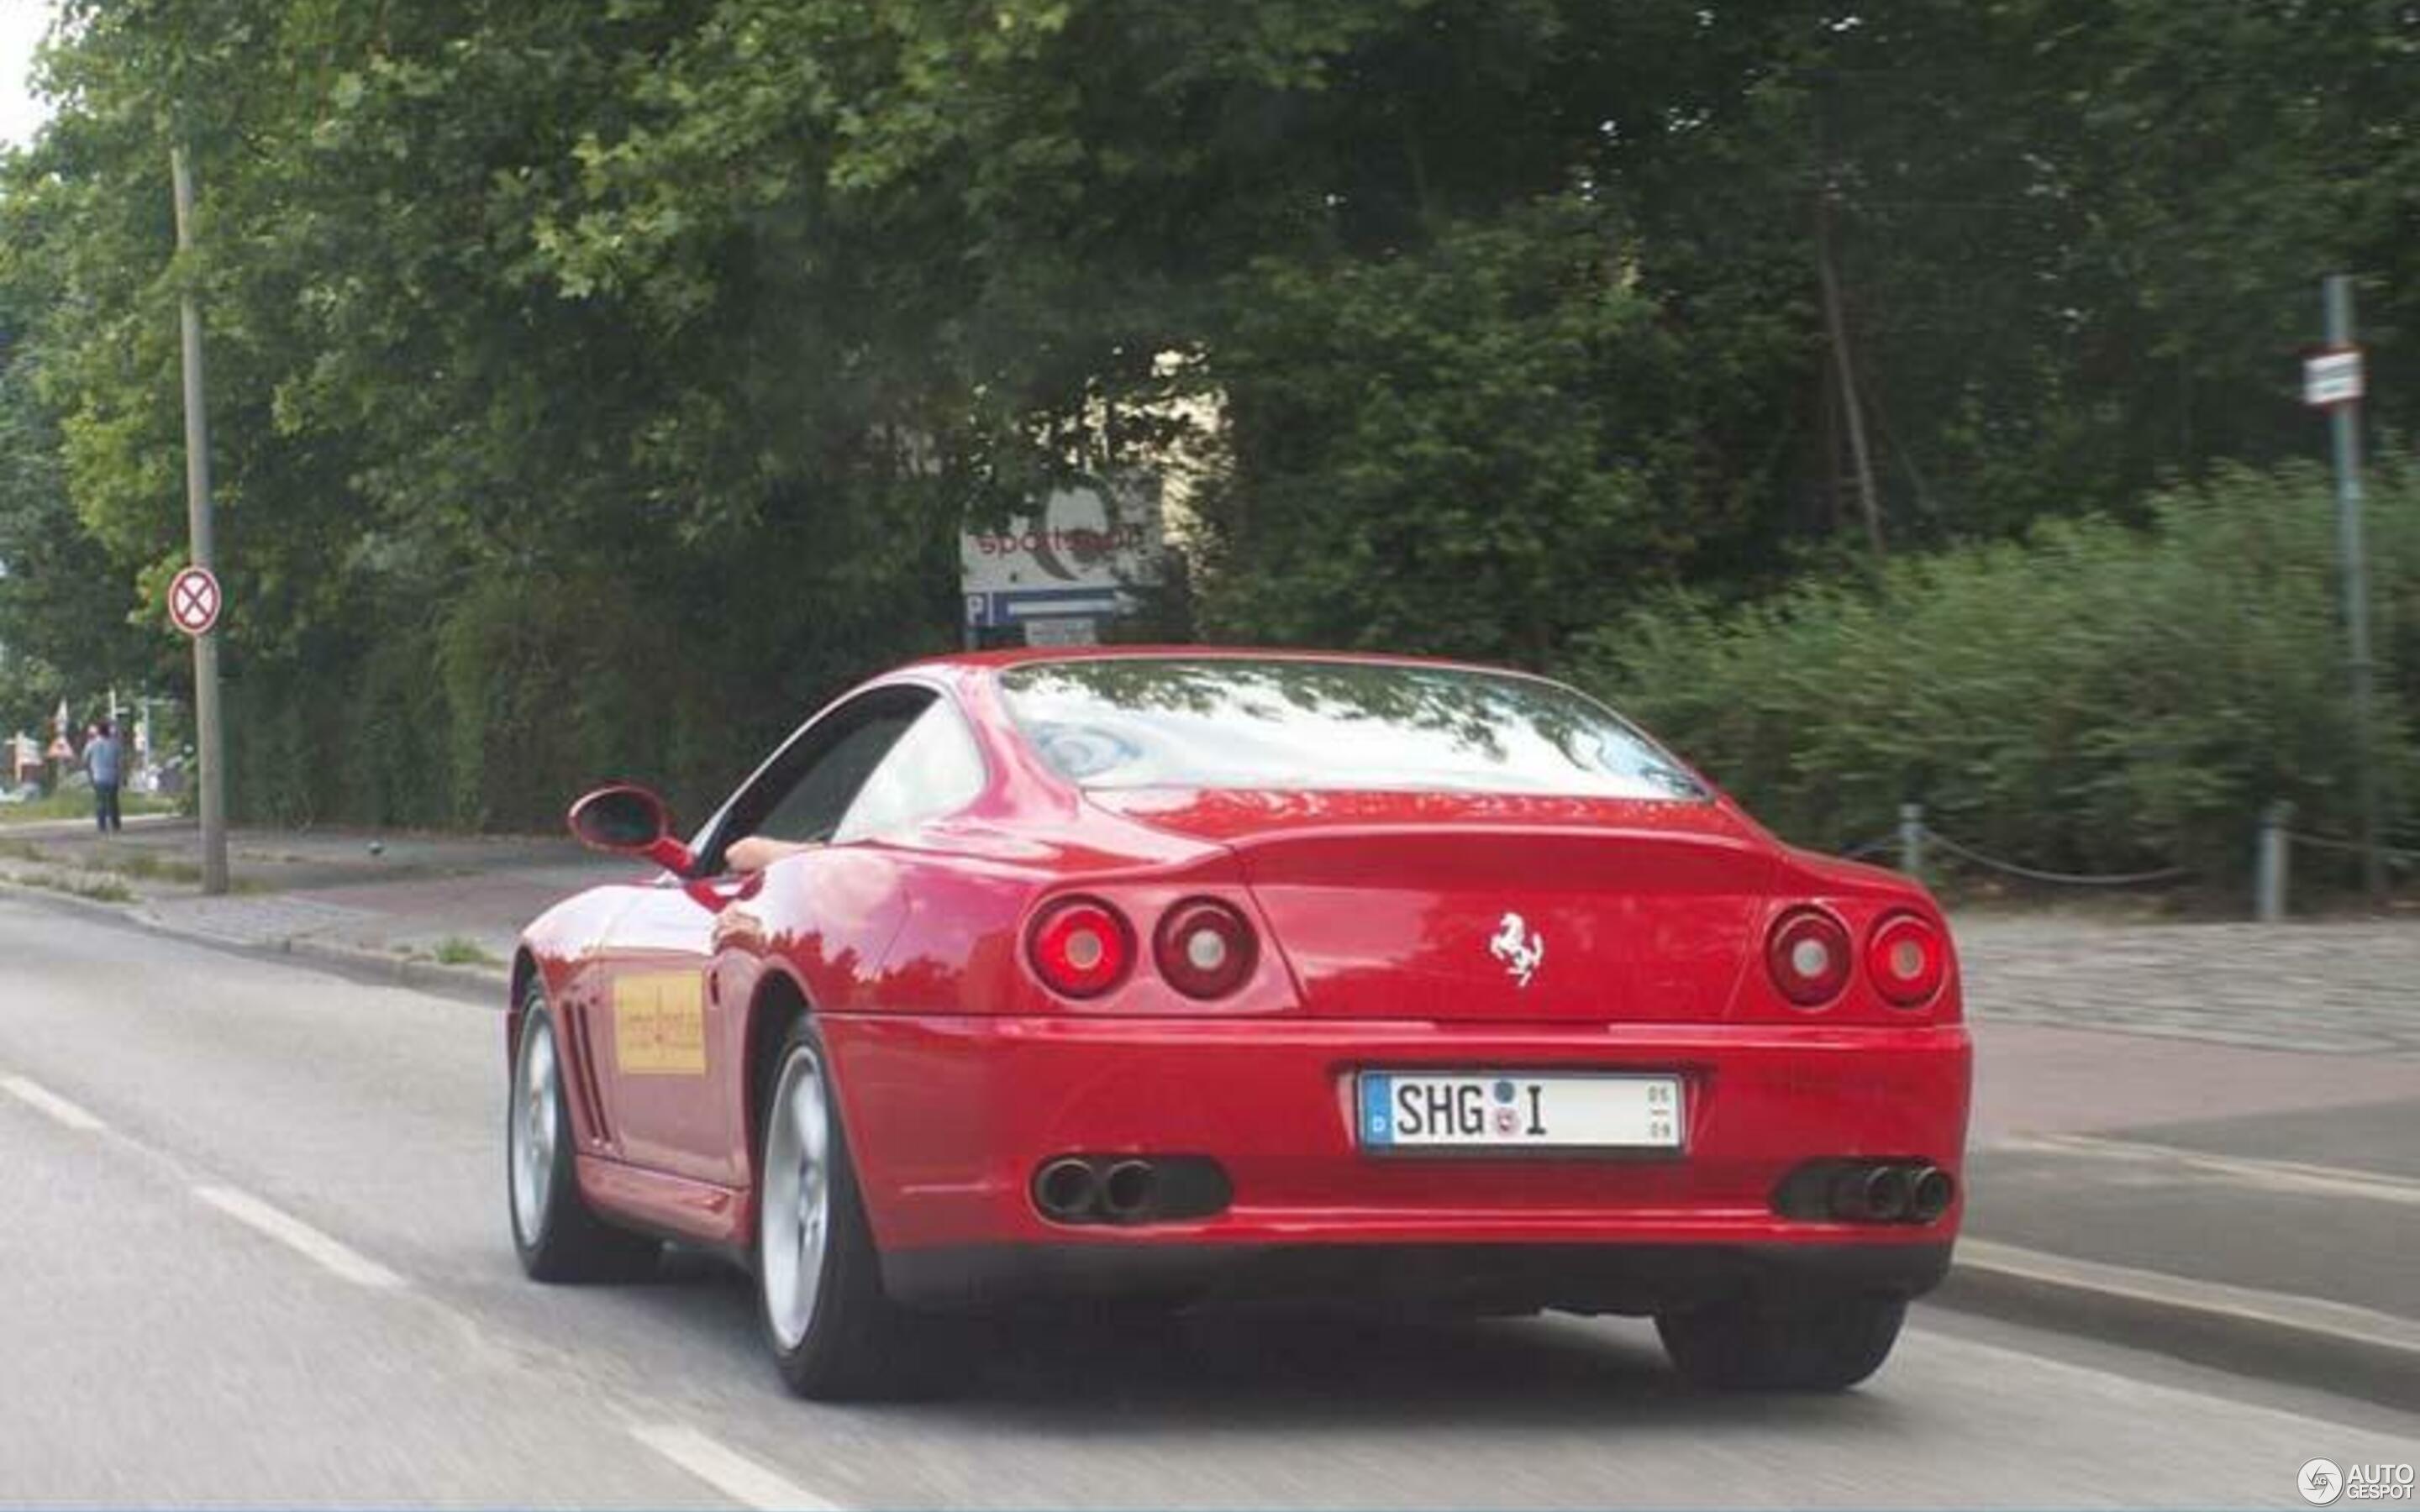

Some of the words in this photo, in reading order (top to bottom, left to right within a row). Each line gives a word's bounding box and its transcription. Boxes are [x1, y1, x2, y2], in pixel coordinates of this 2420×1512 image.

[966, 596, 984, 626] P
[1372, 1116, 1386, 1132] D
[1397, 1084, 1484, 1136] SHG
[1526, 1084, 1546, 1136] I
